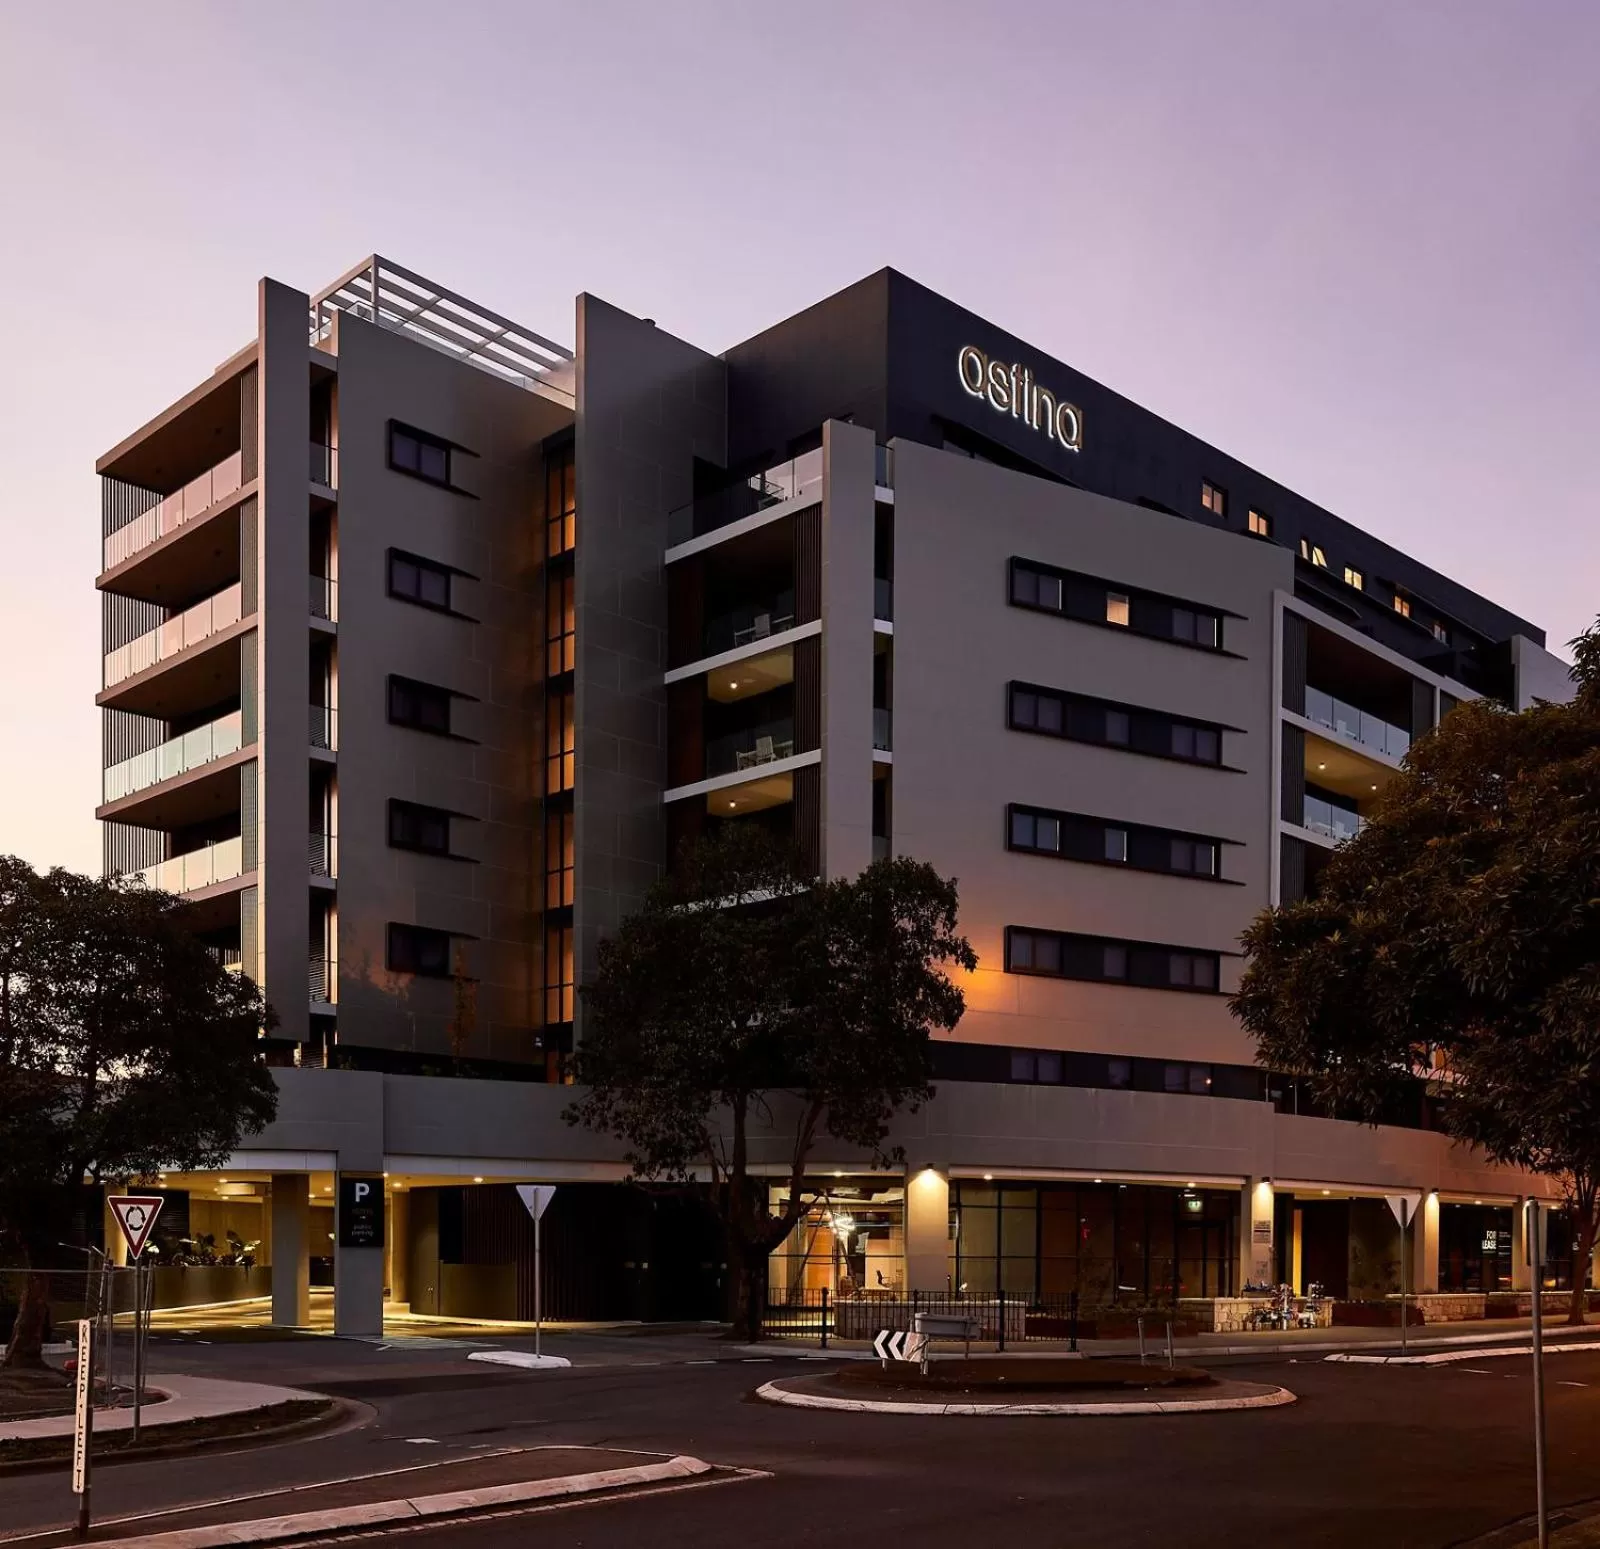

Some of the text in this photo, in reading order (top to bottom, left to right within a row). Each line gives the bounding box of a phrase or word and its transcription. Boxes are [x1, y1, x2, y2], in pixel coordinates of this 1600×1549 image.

[958, 345, 1083, 452] astina
[355, 1183, 370, 1202] P
[1486, 1230, 1497, 1239] FOR
[1482, 1240, 1497, 1250] LEASE
[76, 1325, 89, 1489] KEEP LEFT
